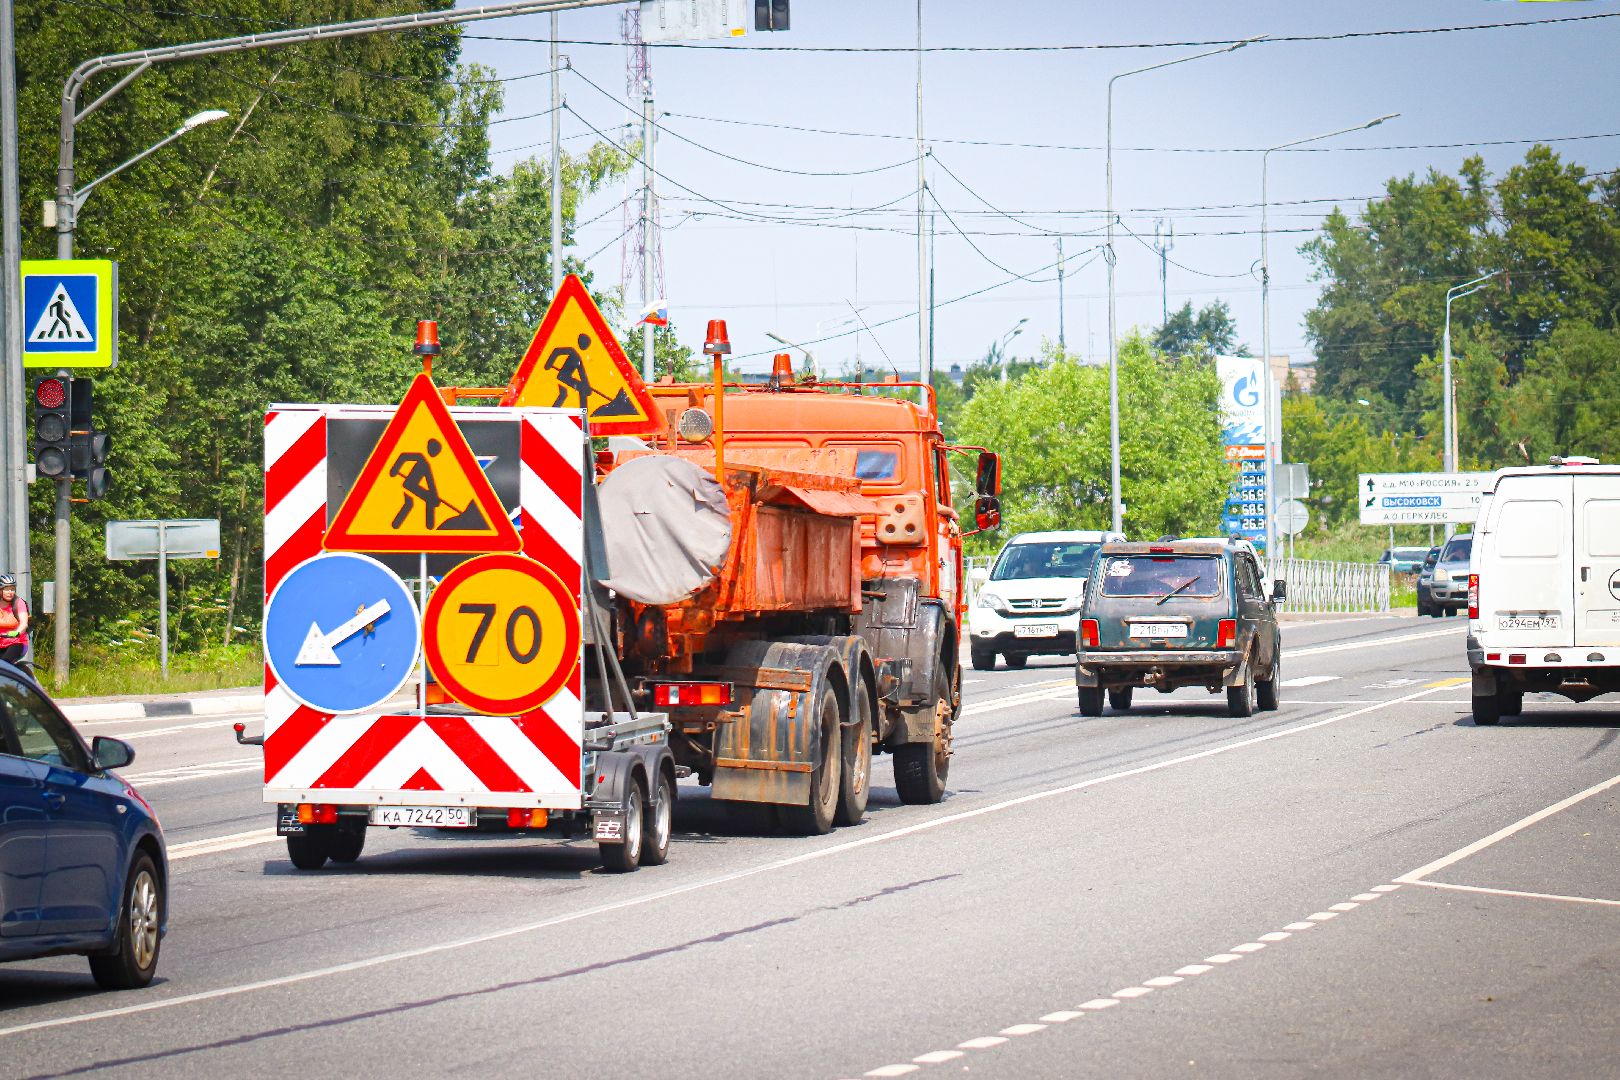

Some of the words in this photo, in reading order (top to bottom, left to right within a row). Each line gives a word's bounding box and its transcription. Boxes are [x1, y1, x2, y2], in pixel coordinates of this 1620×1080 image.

[1383, 496, 1441, 507] ВЫСОКОВСК
[458, 603, 542, 664] 70
[383, 811, 401, 823] КА
[405, 808, 443, 823] 7242
[448, 808, 463, 820] 50
